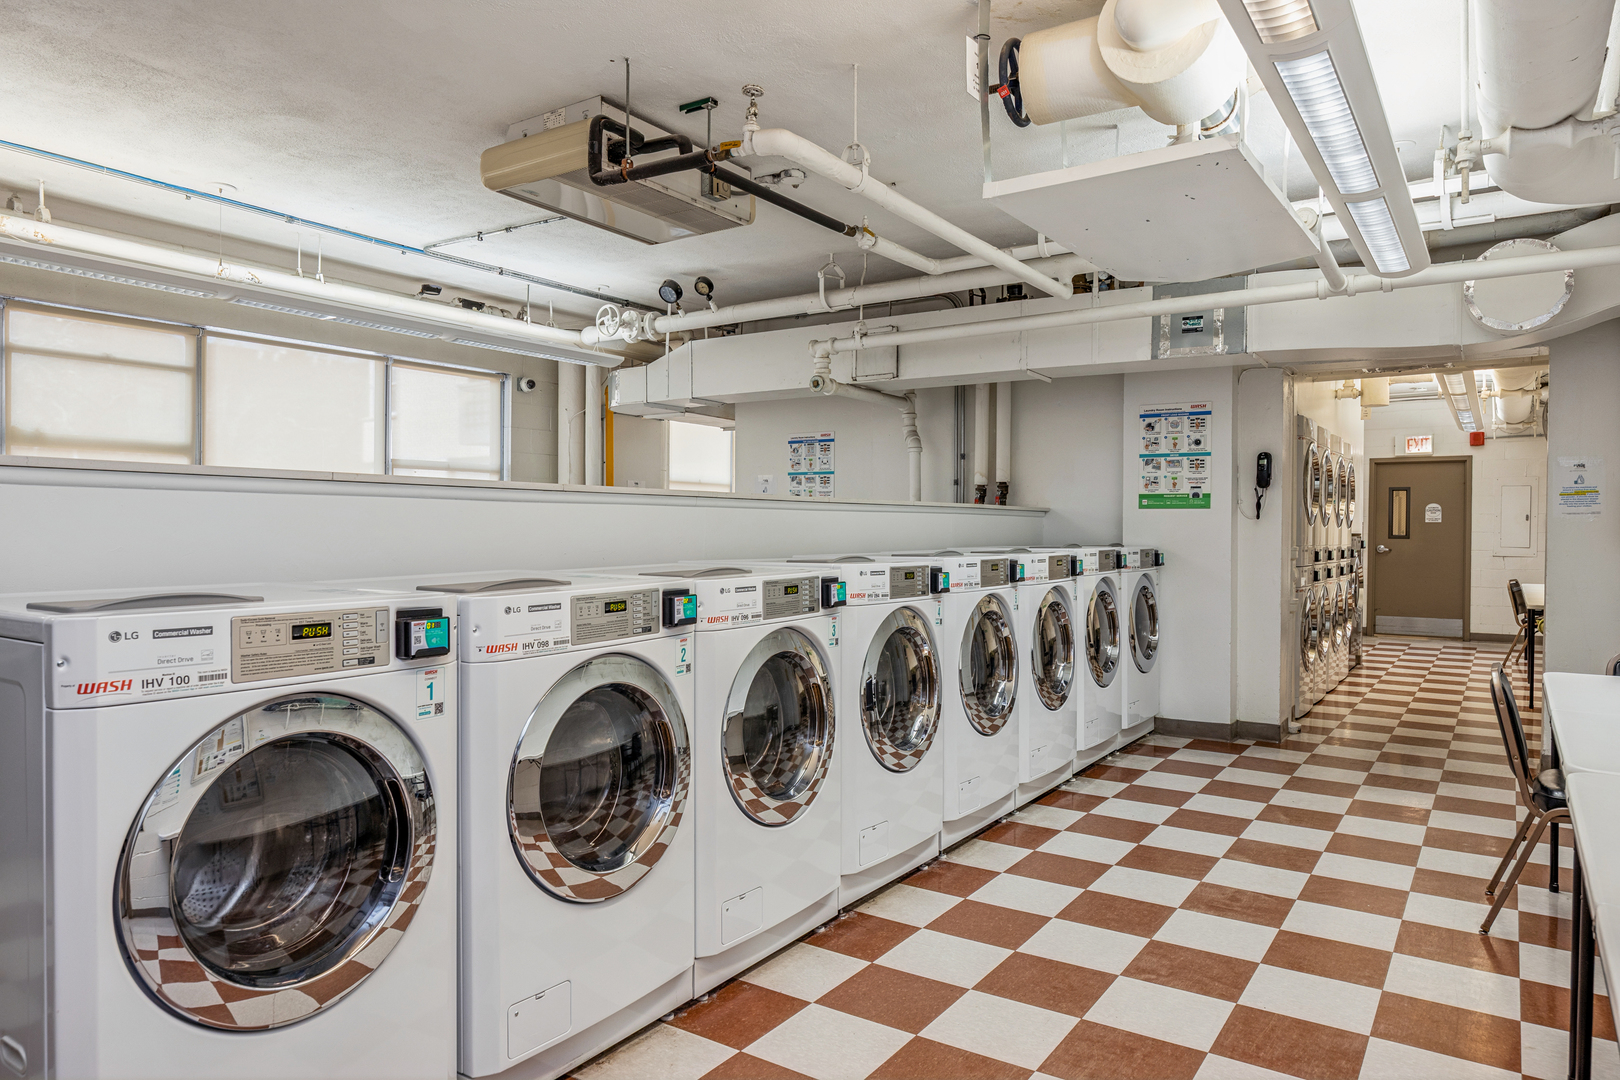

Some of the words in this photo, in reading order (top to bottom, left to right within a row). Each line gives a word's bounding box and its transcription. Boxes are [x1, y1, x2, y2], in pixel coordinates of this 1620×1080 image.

[1407, 437, 1430, 452] EXIT
[610, 603, 625, 612] PUSH
[707, 615, 729, 624] WASH
[124, 631, 139, 640] LG
[154, 629, 189, 638] Commercial
[303, 627, 329, 637] PUSH
[832, 624, 836, 637] 3
[486, 642, 518, 654] WASH
[522, 642, 535, 650] IHV
[680, 648, 686, 663] 2
[77, 679, 133, 694] WASH
[142, 678, 164, 689] IHV
[169, 675, 190, 686] 100
[426, 682, 433, 700] 1
